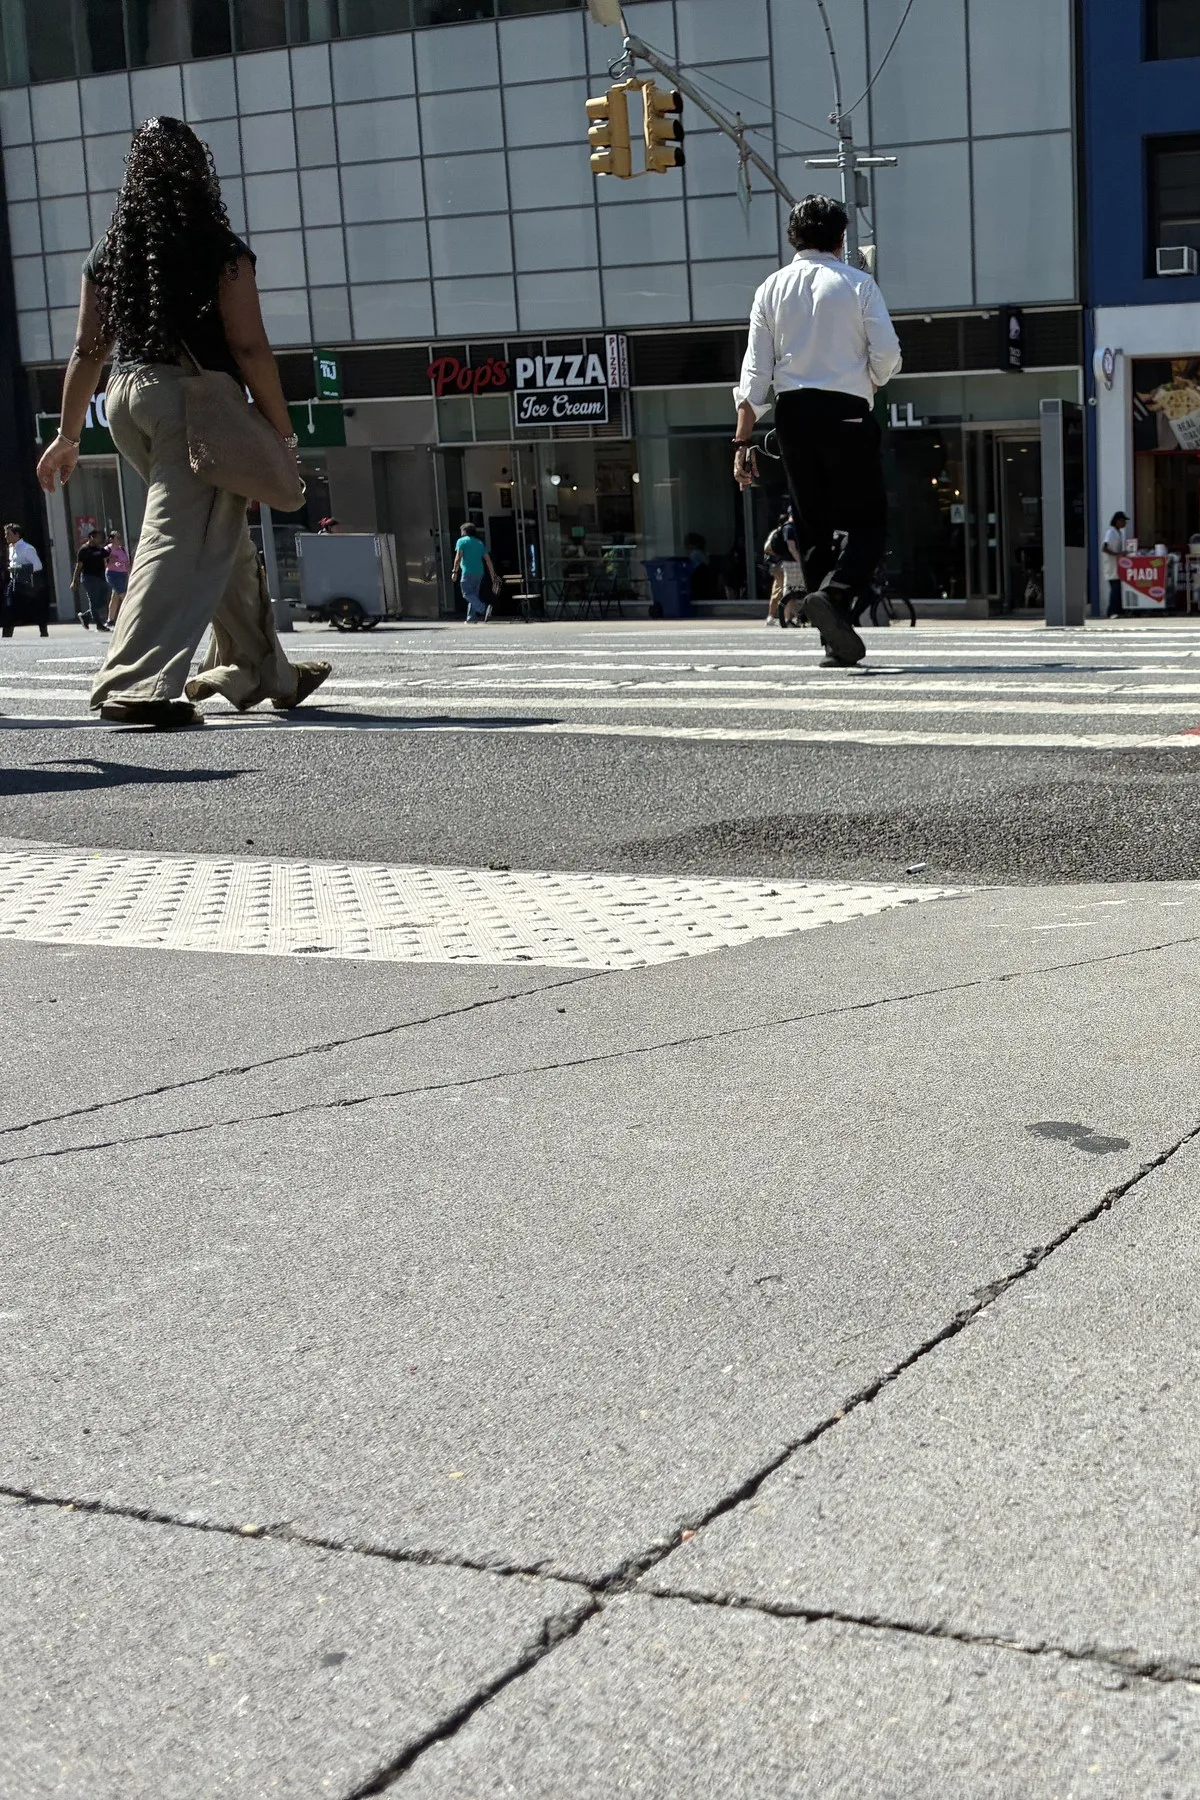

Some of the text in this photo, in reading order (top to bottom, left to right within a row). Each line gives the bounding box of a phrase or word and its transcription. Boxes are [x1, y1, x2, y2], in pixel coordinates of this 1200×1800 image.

[515, 354, 606, 388] PIZZA
[609, 337, 617, 385] PIZZA
[520, 395, 604, 419] Ice Cream
[886, 402, 923, 428] LL
[1126, 568, 1158, 581] PIADI
